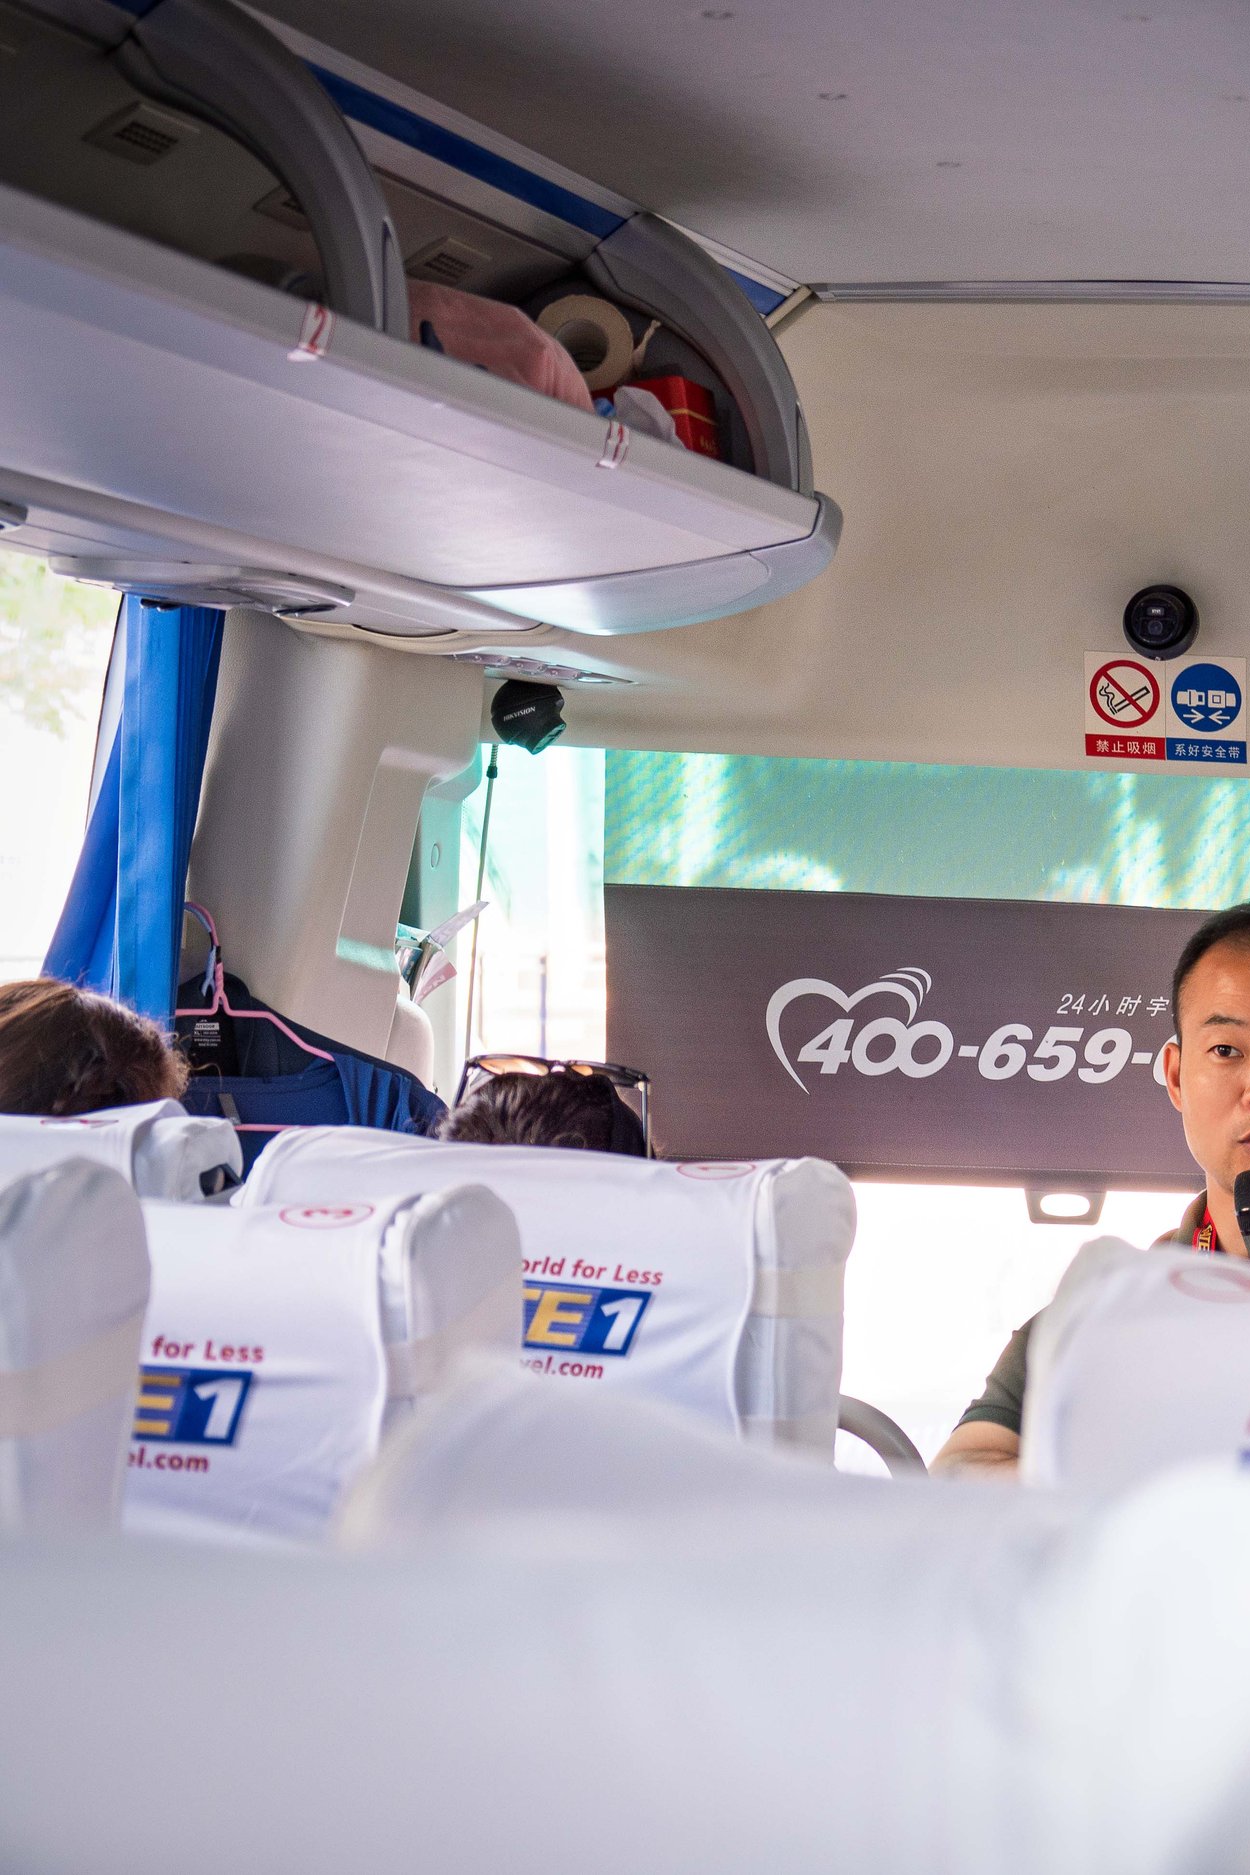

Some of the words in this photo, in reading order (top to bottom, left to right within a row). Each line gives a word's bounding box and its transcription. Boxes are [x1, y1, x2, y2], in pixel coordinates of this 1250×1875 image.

[503, 705, 536, 722] HIKVISION
[1095, 738, 1157, 756] 禁止吸烟
[1173, 742, 1241, 760] 系好安全带
[1056, 992, 1174, 1018] 24小时宇
[797, 1017, 1179, 1087] 400-659-
[521, 1256, 566, 1277] orld
[572, 1258, 607, 1280] for
[613, 1264, 663, 1286] Less
[152, 1334, 194, 1360] for
[204, 1340, 264, 1363] Less
[519, 1356, 603, 1380] vel.com
[129, 1446, 210, 1473] l.com
